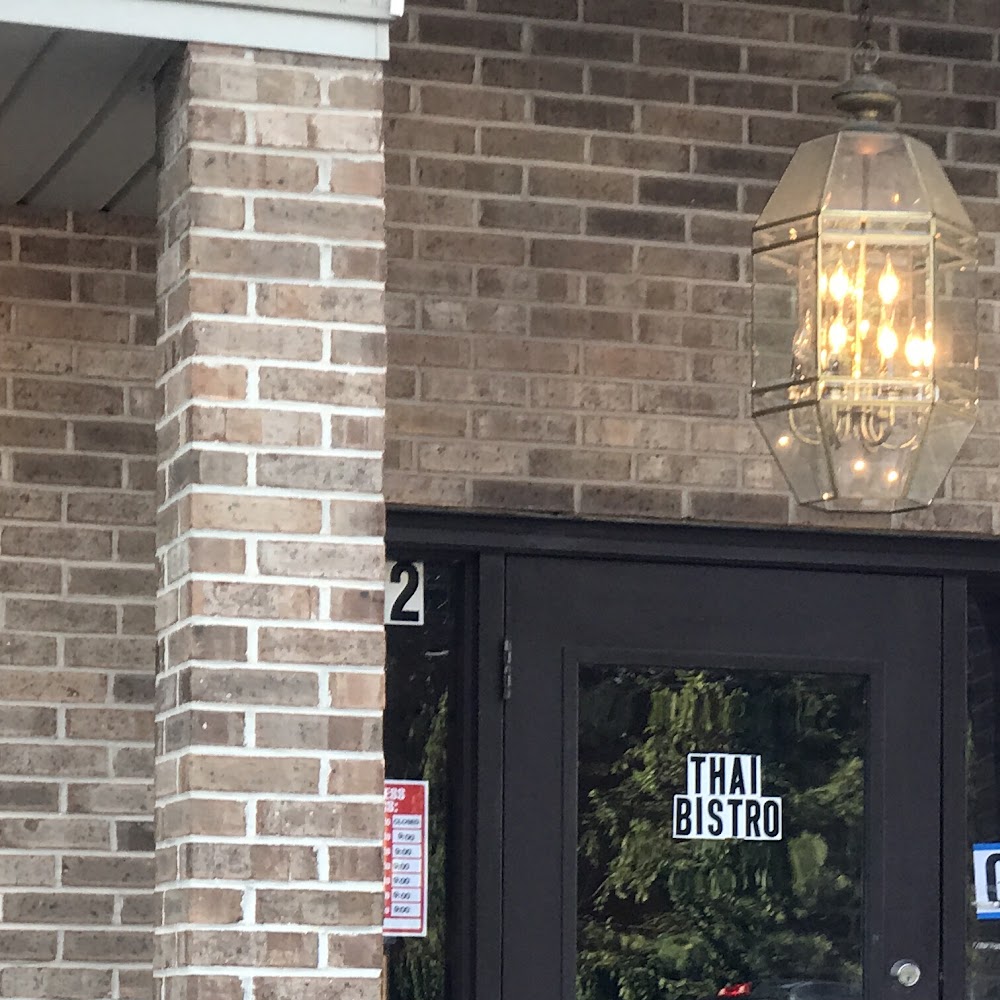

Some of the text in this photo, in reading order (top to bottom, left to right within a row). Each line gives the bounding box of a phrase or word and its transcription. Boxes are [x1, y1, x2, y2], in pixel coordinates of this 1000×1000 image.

[390, 561, 419, 622] 2
[690, 756, 757, 795] THAI
[676, 797, 779, 838] BISTRO
